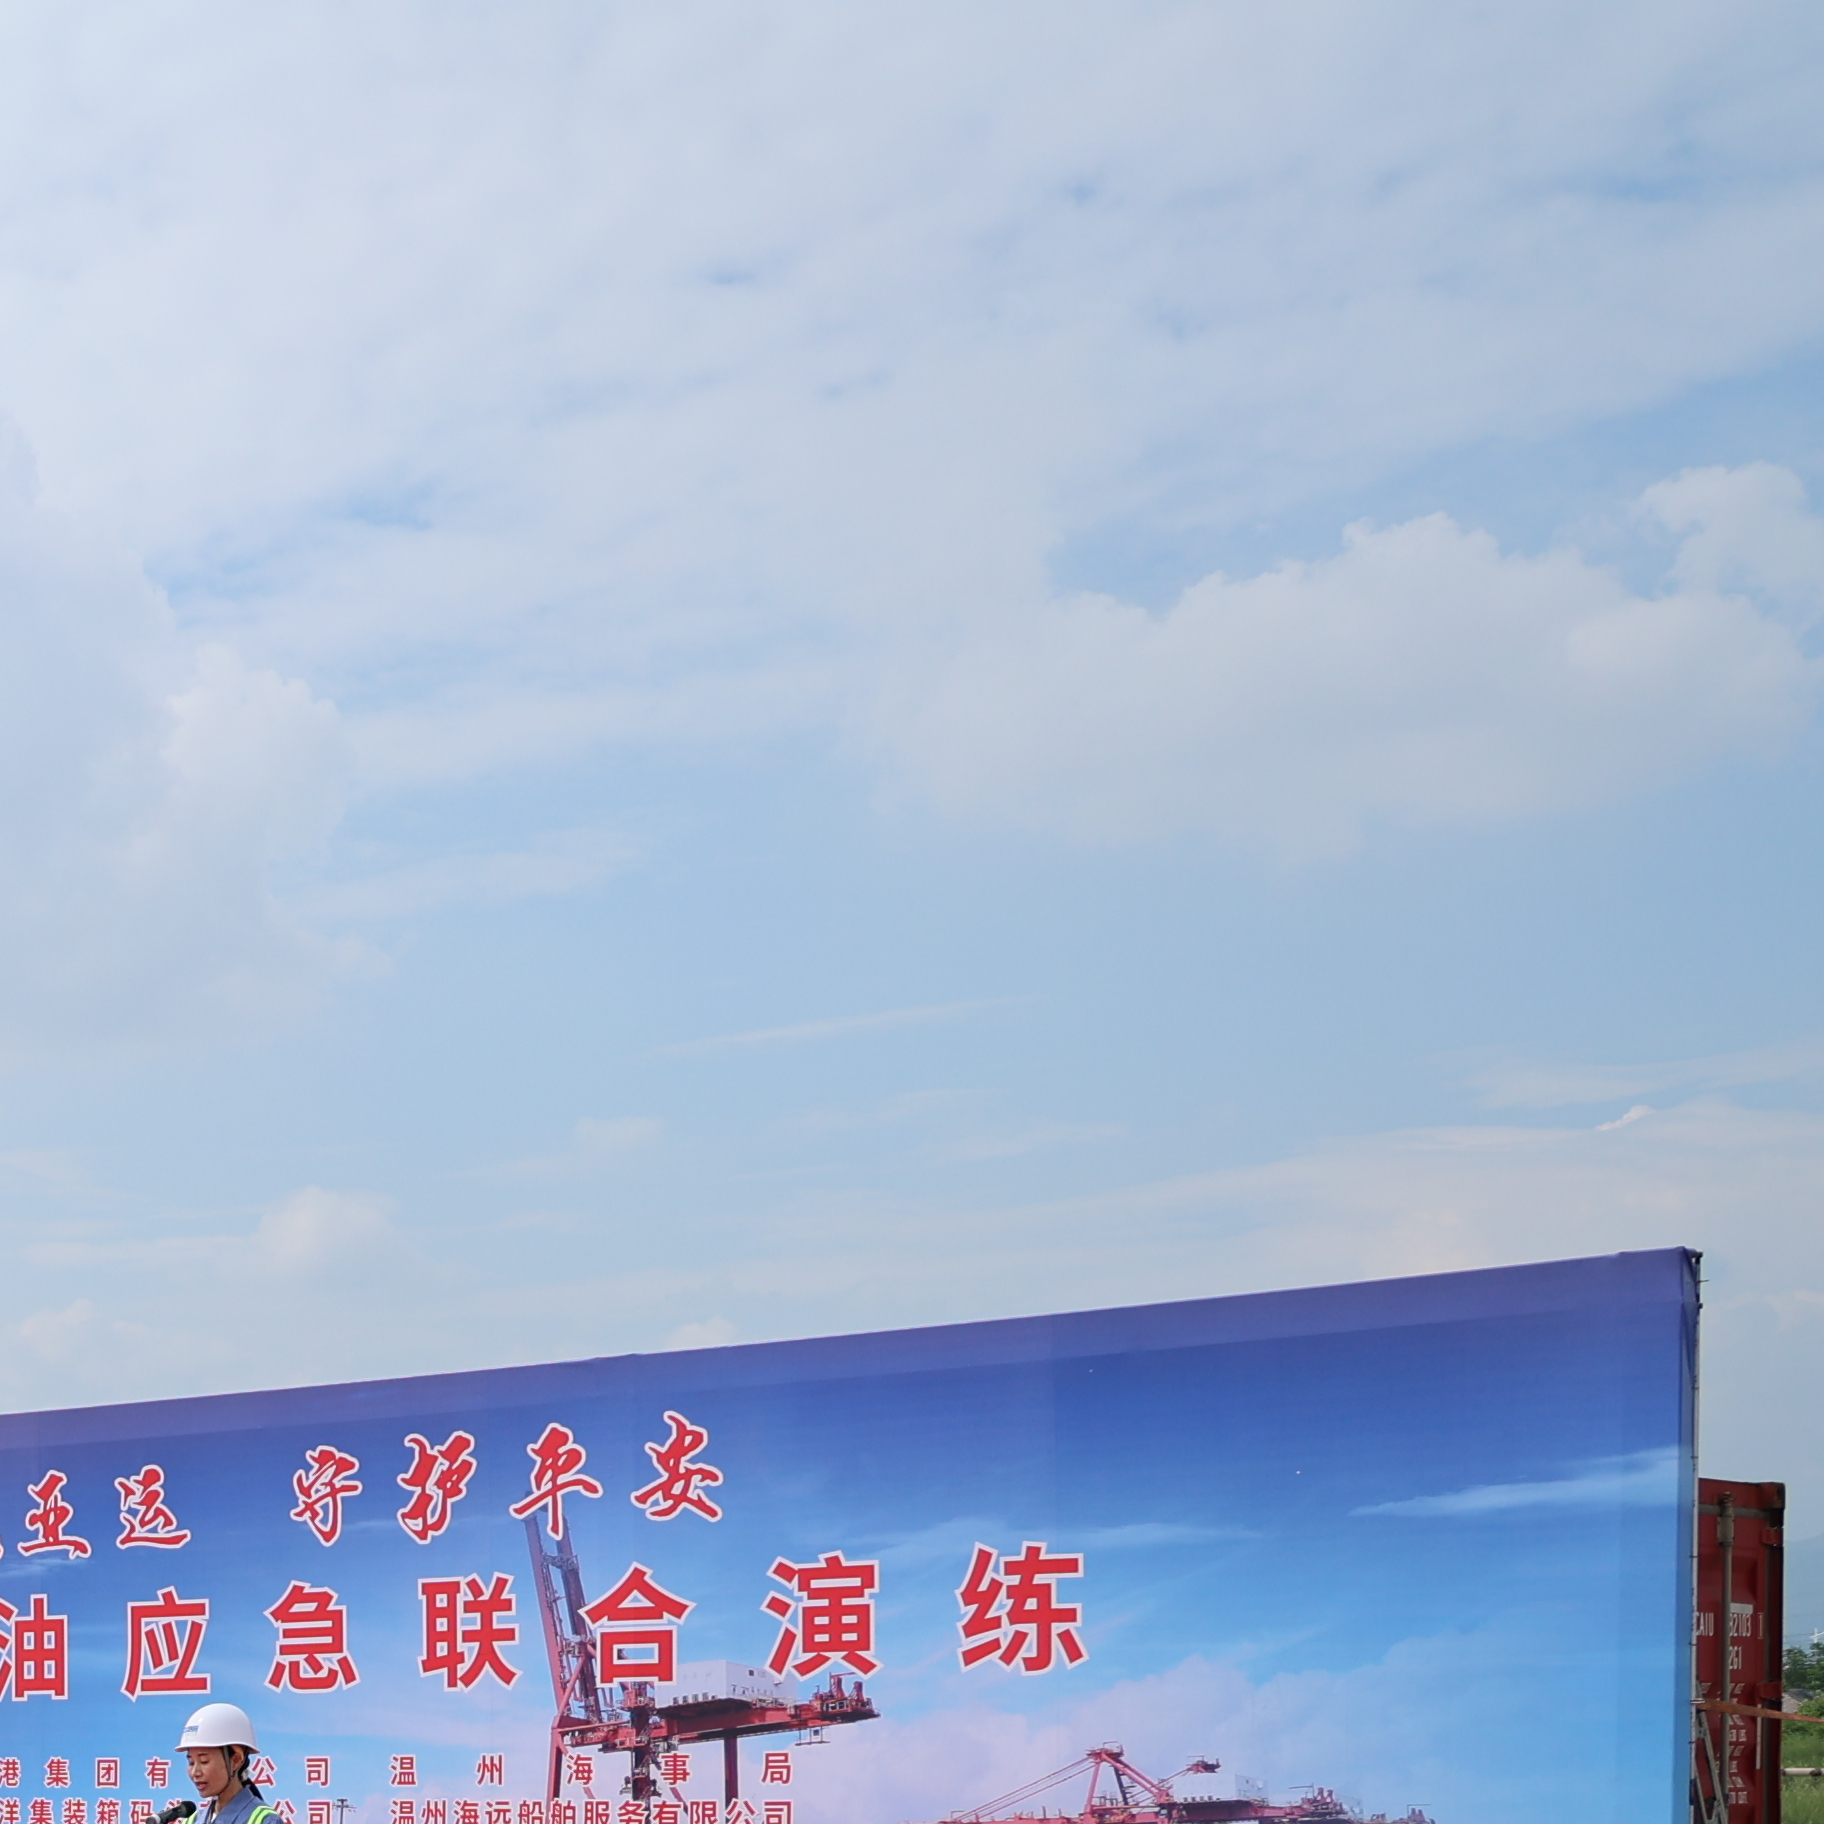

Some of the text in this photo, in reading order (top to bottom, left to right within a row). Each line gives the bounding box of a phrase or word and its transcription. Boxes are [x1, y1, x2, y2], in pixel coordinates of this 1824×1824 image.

[290, 1411, 724, 1546] 守护平安
[389, 1752, 793, 1786] 温州海事局
